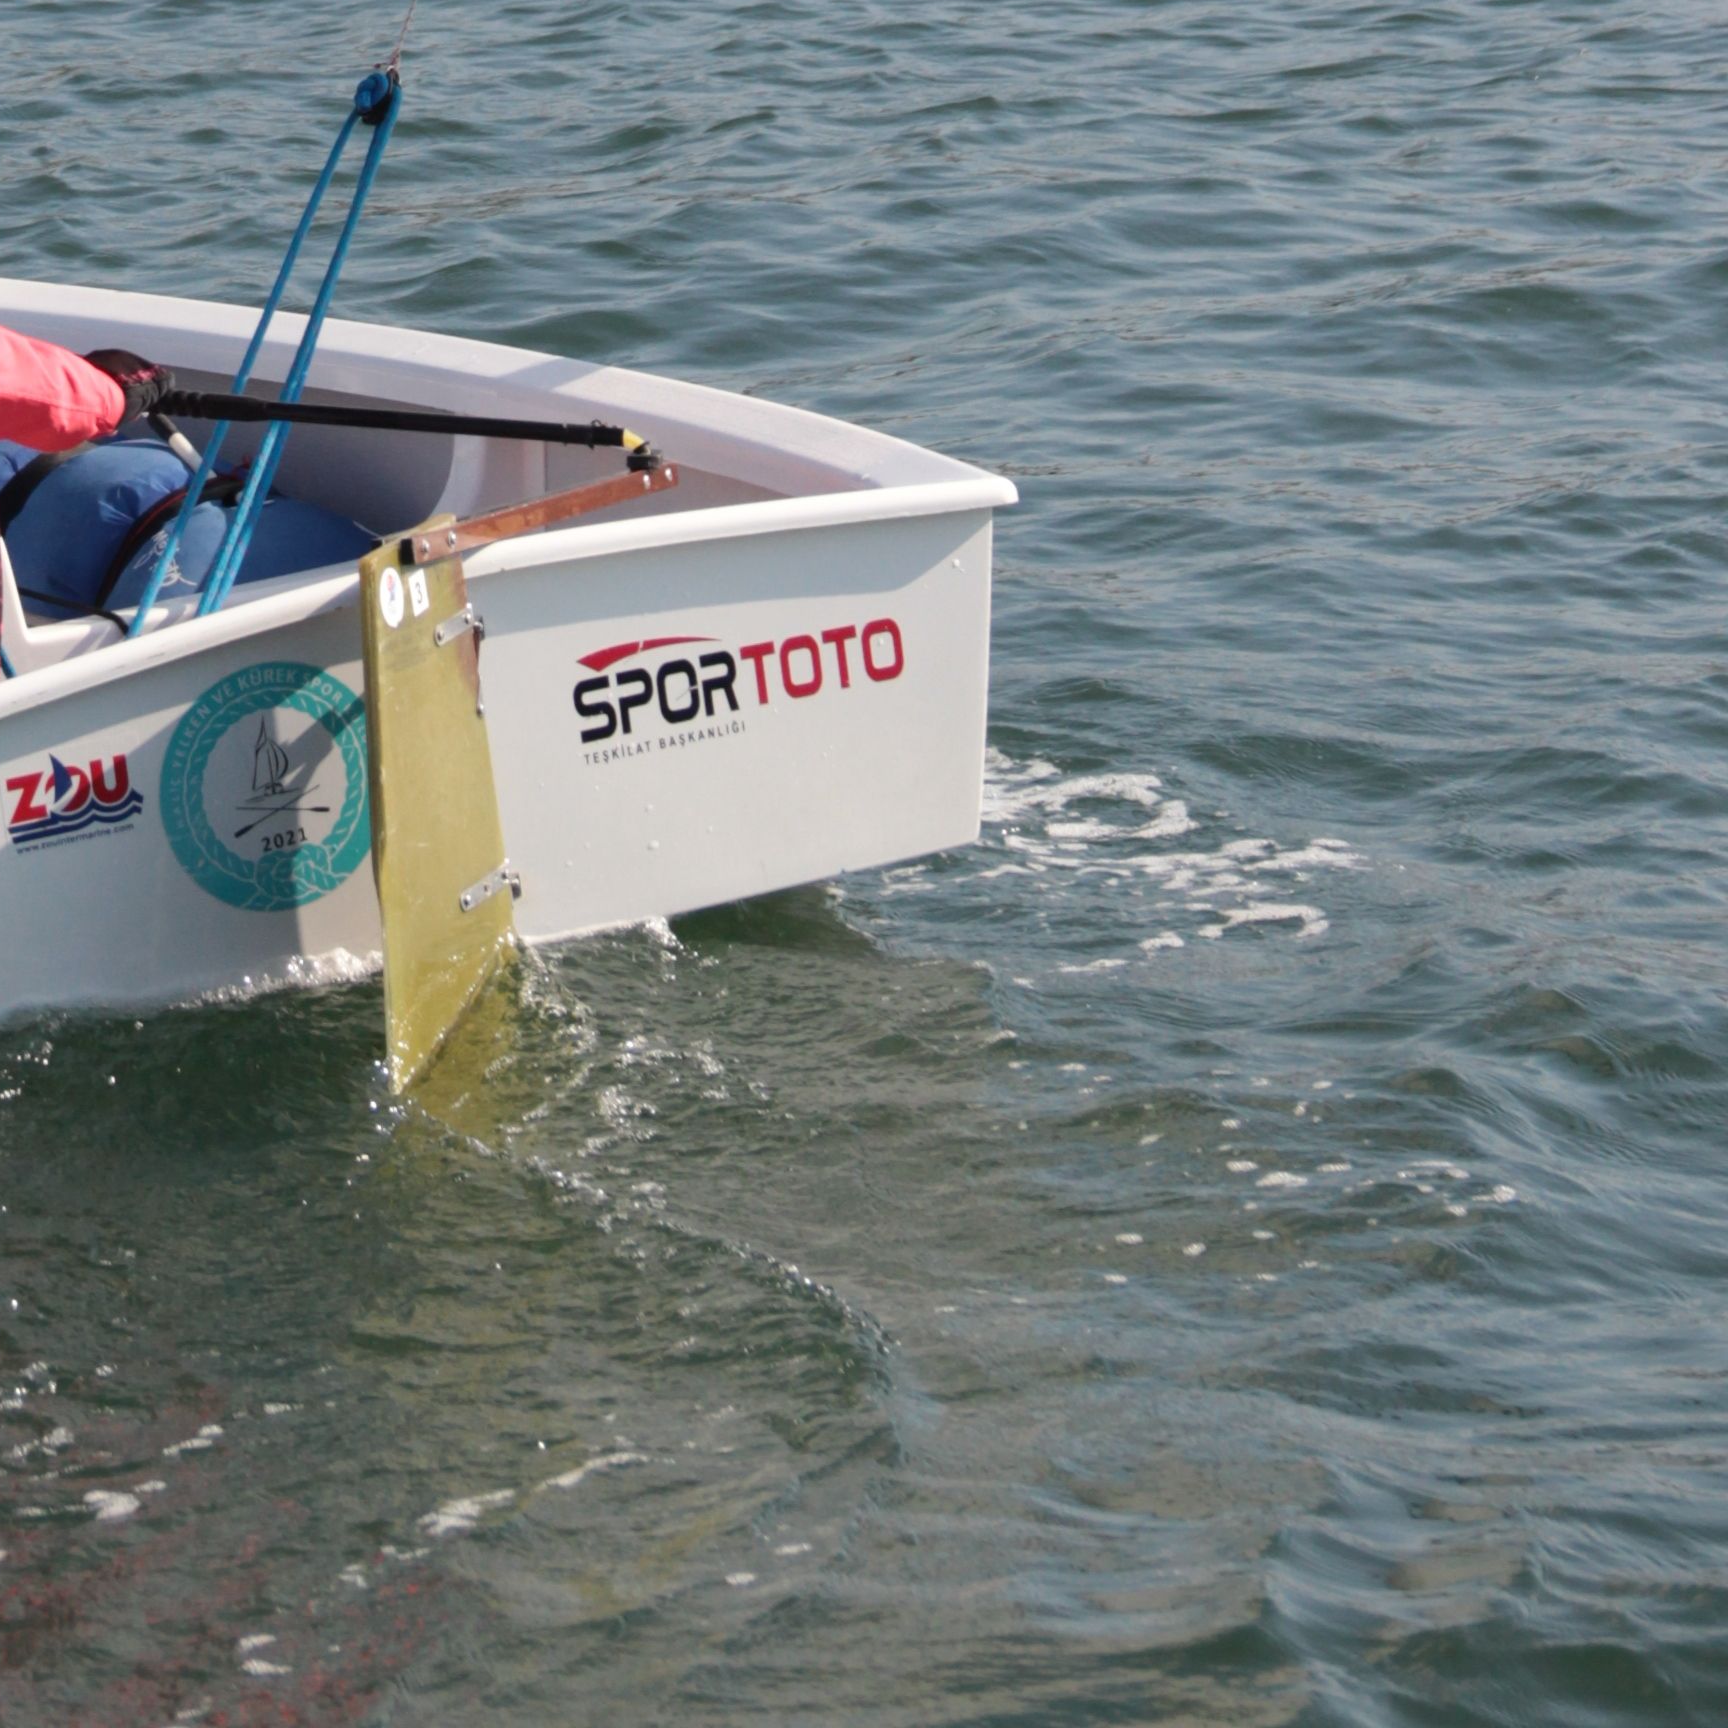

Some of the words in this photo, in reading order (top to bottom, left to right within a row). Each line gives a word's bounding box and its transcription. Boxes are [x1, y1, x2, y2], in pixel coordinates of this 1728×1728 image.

[414, 581, 423, 604] 3
[211, 683, 233, 706] VE
[238, 667, 296, 691] KÜREK
[303, 675, 343, 702] SPOR
[583, 740, 652, 766] TEŞKİLAT
[659, 720, 747, 750] BAŞKANLIĞI
[262, 827, 308, 852] 2021
